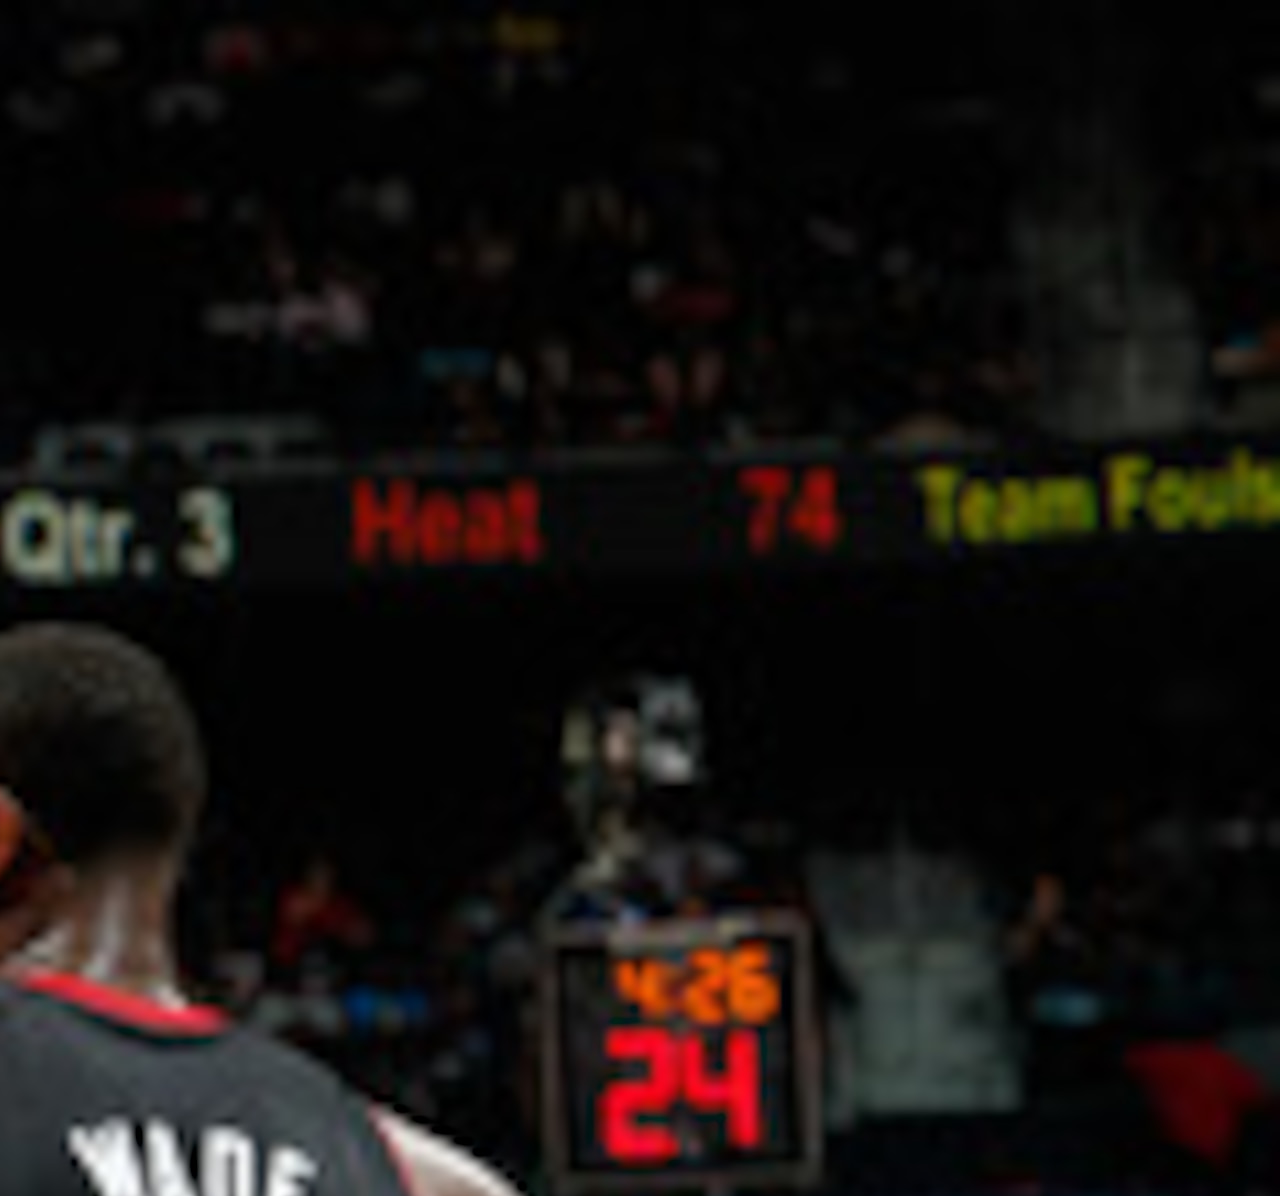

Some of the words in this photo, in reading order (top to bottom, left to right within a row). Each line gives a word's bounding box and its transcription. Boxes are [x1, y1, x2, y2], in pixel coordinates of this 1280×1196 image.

[176, 487, 234, 578] 3
[350, 478, 544, 564] Heat
[740, 468, 840, 554] 74
[918, 464, 1100, 544] Team
[612, 944, 782, 1026] 4:26
[600, 1027, 762, 1164] 24
